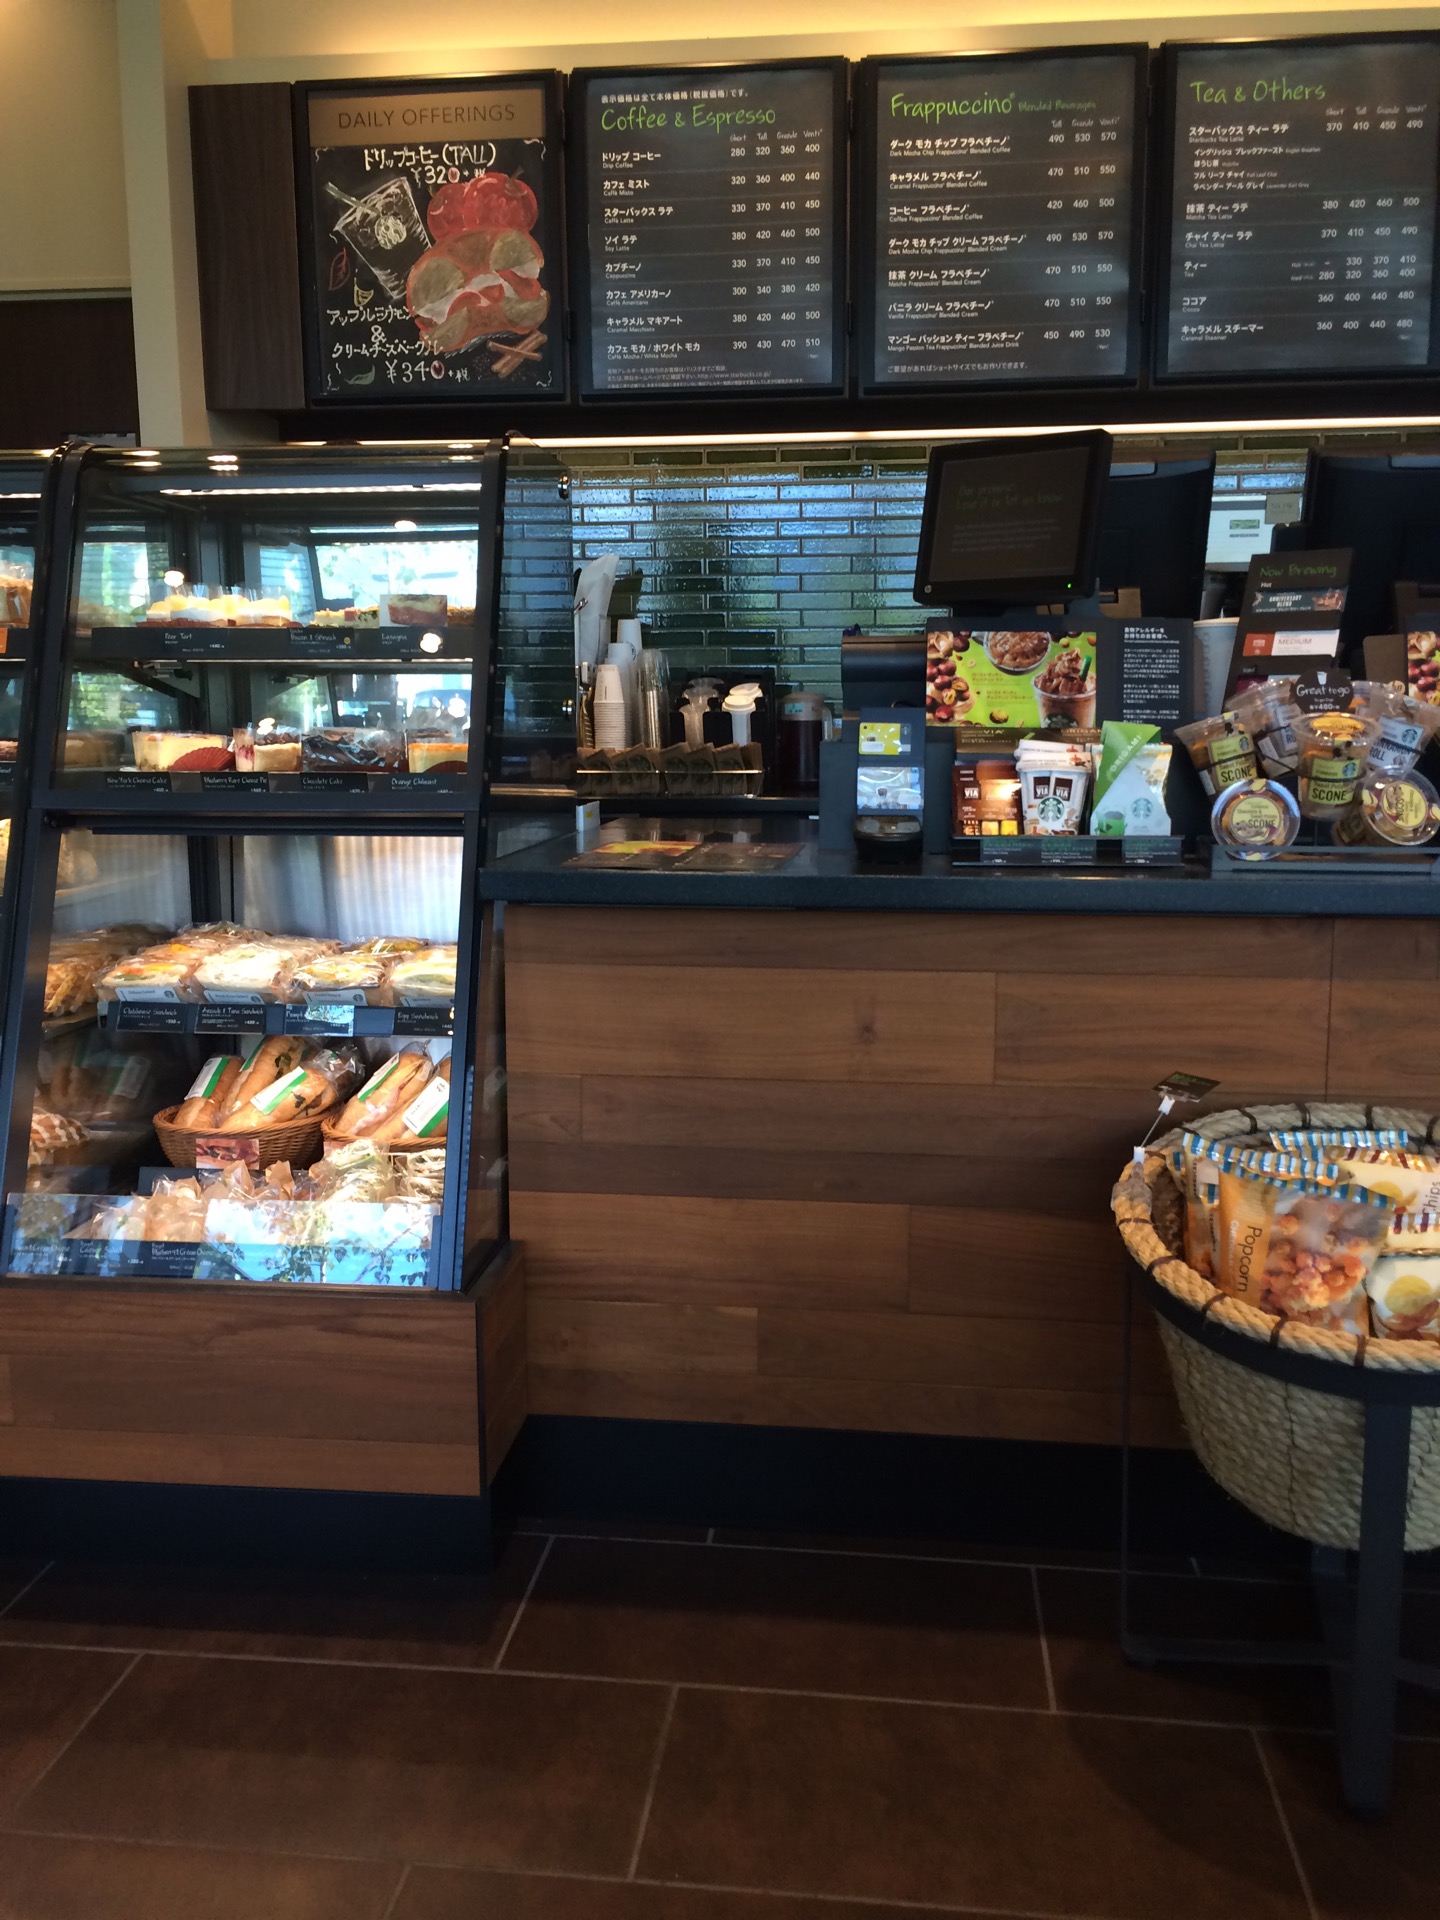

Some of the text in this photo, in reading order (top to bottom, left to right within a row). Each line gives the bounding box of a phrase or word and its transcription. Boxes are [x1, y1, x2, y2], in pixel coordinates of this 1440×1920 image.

[1190, 77, 1325, 103] Tea & Others
[338, 105, 515, 128] DAILY OFFERINGS
[601, 104, 776, 133] Coffee & Espresso
[1189, 126, 1244, 135] スターバックス
[1272, 124, 1288, 134] ラテ
[1326, 122, 1342, 132] 370
[1353, 122, 1369, 131] 410
[1380, 121, 1396, 130] 450
[1407, 120, 1423, 129] 490
[915, 139, 931, 148] モカ
[1049, 134, 1065, 144] 490
[1075, 133, 1091, 142] 530
[1101, 132, 1117, 141] 570
[442, 143, 496, 166] (TALL)
[602, 144, 820, 162] ドリップ コーヒー 280 320 360 400
[603, 171, 820, 190] カフェ ミスト 320 360 400 440
[890, 172, 929, 181] キャラメル
[604, 199, 820, 217] スターバックス ラテ 330 370 410 450
[889, 206, 917, 215] コーヒー
[1232, 203, 1248, 212] ラテ
[605, 234, 637, 244] ソイ ラテ
[1236, 231, 1252, 240] ラテ
[1321, 229, 1337, 238] 370
[1348, 228, 1364, 237] 410
[1375, 227, 1391, 236] 450
[1401, 226, 1417, 235] 490
[912, 238, 927, 247] モカ
[953, 237, 979, 246] クリーム
[605, 263, 641, 272] カプチーノ
[909, 271, 937, 279] クリーム
[1045, 266, 1061, 275] 470
[1071, 264, 1087, 274] 510
[1097, 263, 1113, 273] 550
[606, 283, 820, 299] カフェ アメリカーノ 300 340 380 420
[1182, 290, 1414, 306] ココア 360 400 440 480
[915, 303, 943, 311] クリーム
[1044, 298, 1060, 308] 470
[1070, 297, 1086, 307] 510
[1096, 296, 1112, 306] 550
[607, 316, 682, 326] キャラメル マキアート
[371, 325, 386, 342] &
[1181, 325, 1221, 334] キャラメル
[608, 337, 820, 353] カフェ モカ ホワイト モカ 390 430 470 510
[1260, 564, 1337, 578] Now Brewing
[1296, 686, 1326, 697] Great
[1221, 766, 1252, 783] SCONE
[964, 789, 979, 798] VIA
[1036, 788, 1049, 796] VIA
[1056, 789, 1068, 798] VIA
[1312, 788, 1347, 801] SCONE
[1248, 819, 1276, 828] SCONE
[1237, 1225, 1262, 1292] Popcorn
